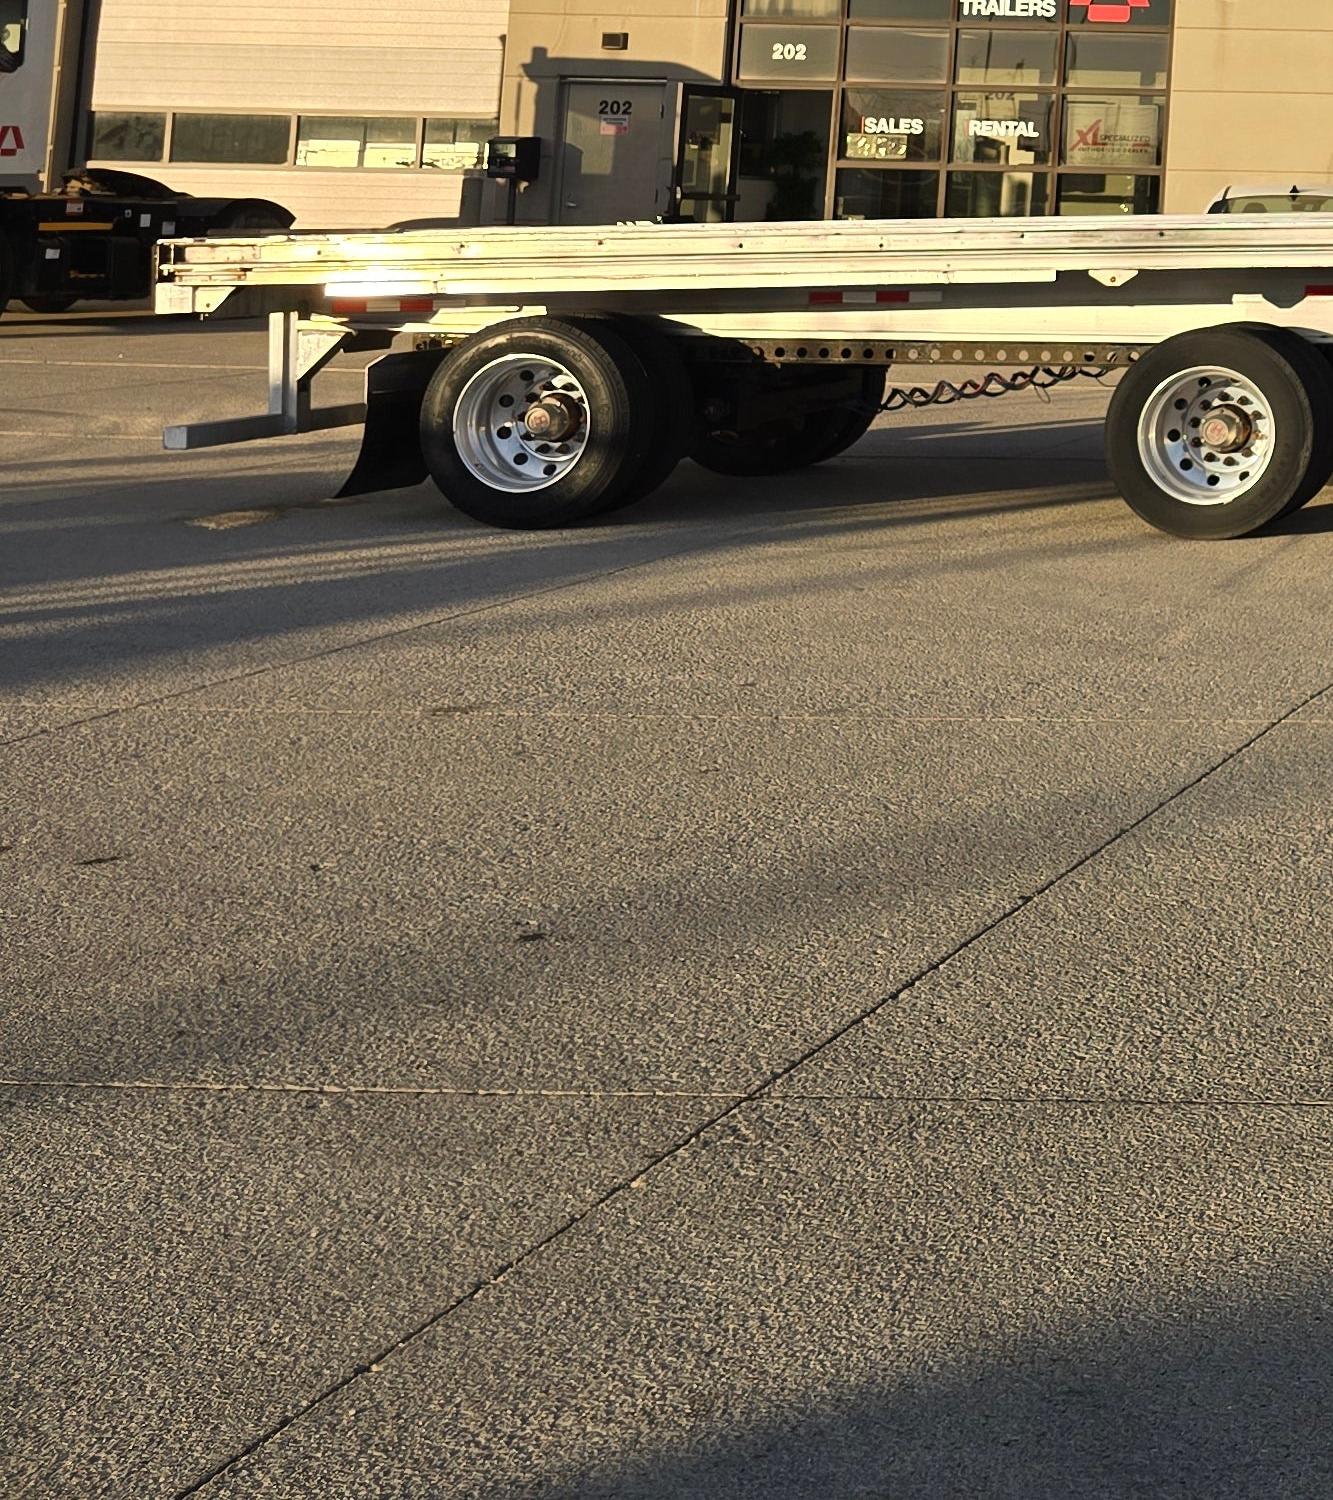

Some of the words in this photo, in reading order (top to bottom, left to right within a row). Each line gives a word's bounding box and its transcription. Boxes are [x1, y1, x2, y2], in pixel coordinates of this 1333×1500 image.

[772, 42, 807, 61] 202
[598, 100, 633, 116] 202
[864, 116, 924, 135] SALES
[968, 119, 1040, 138] RENTAL
[1069, 118, 1108, 152] XL
